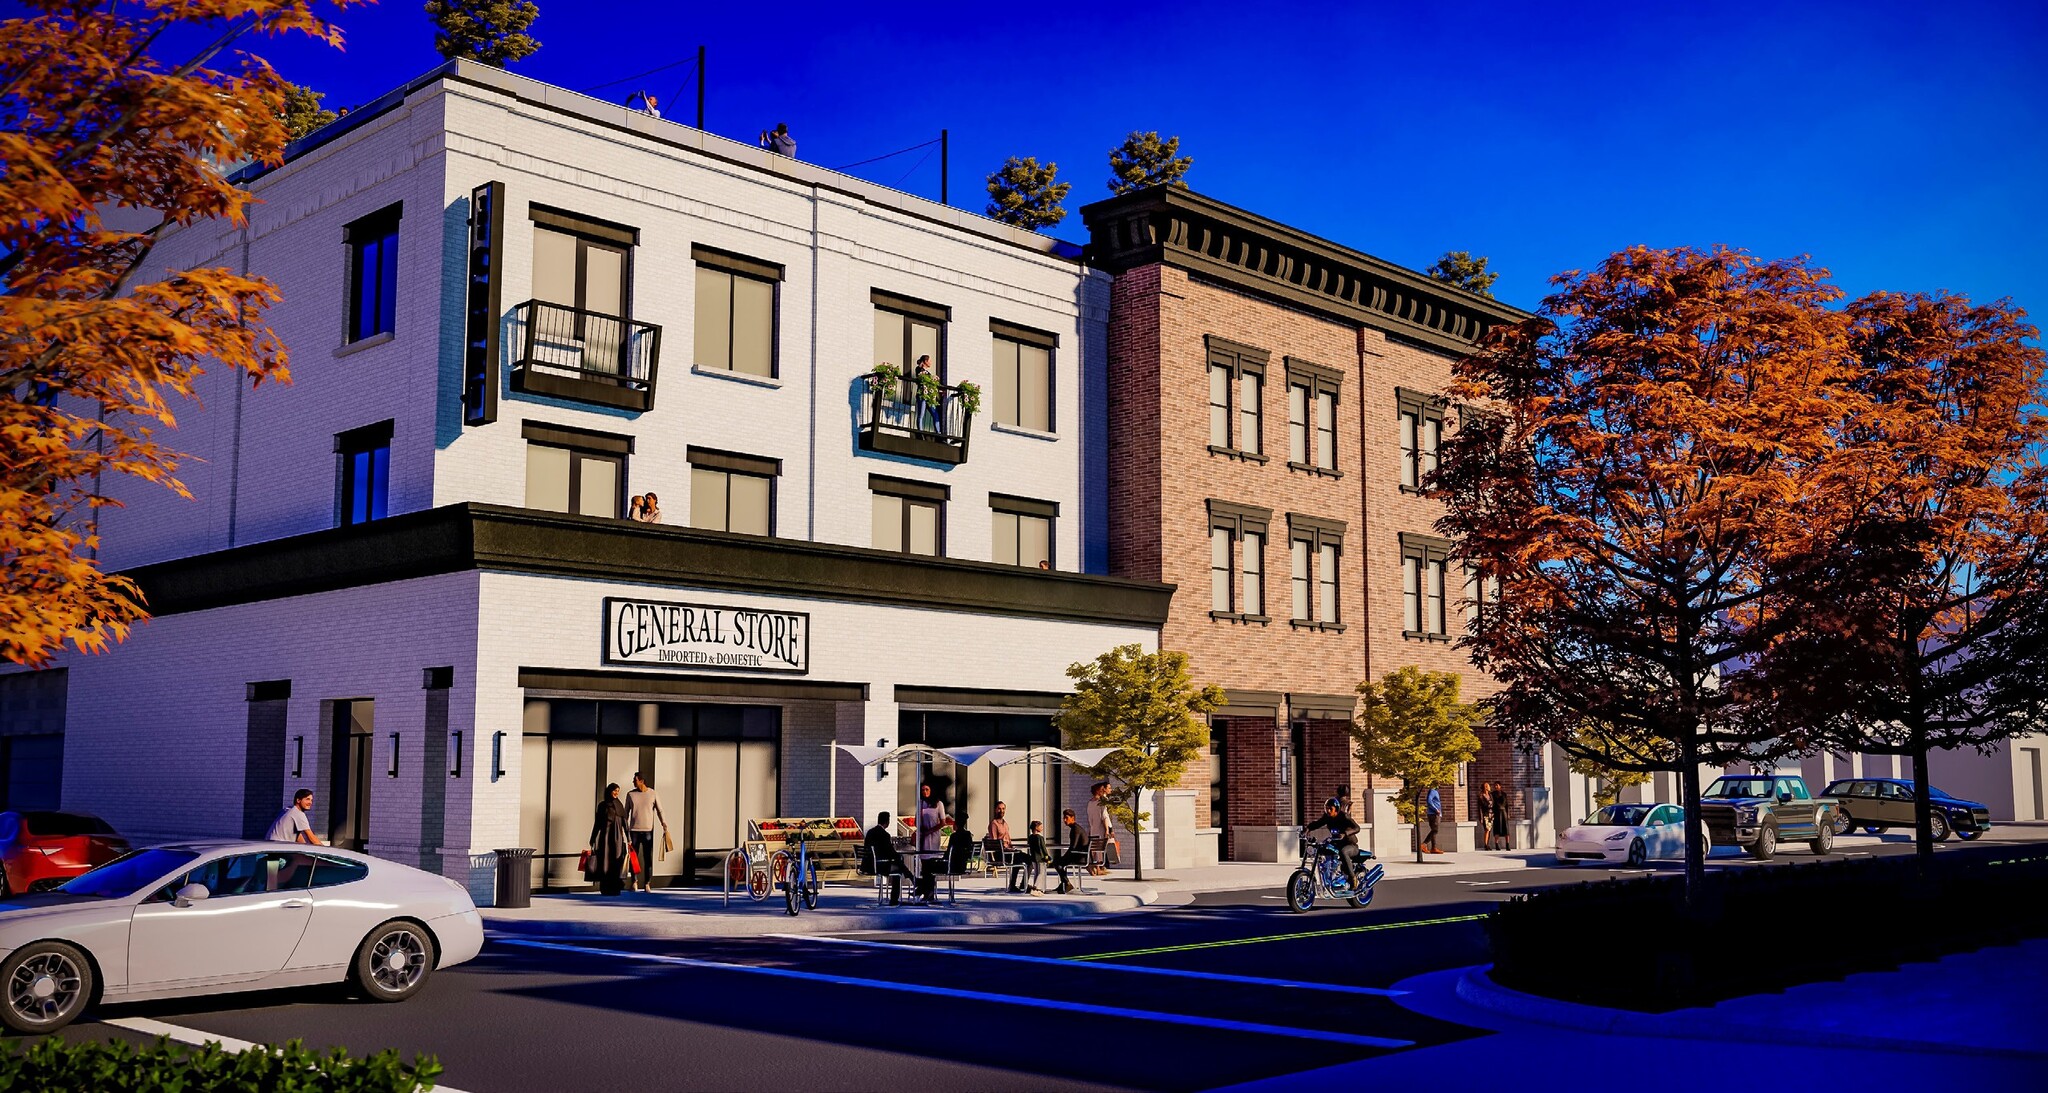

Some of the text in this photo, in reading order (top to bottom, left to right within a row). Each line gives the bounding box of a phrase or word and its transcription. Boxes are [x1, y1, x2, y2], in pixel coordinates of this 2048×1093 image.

[617, 602, 799, 668] GENERAL STORE
[658, 649, 763, 667] IMPORTED & DOMESTIC
